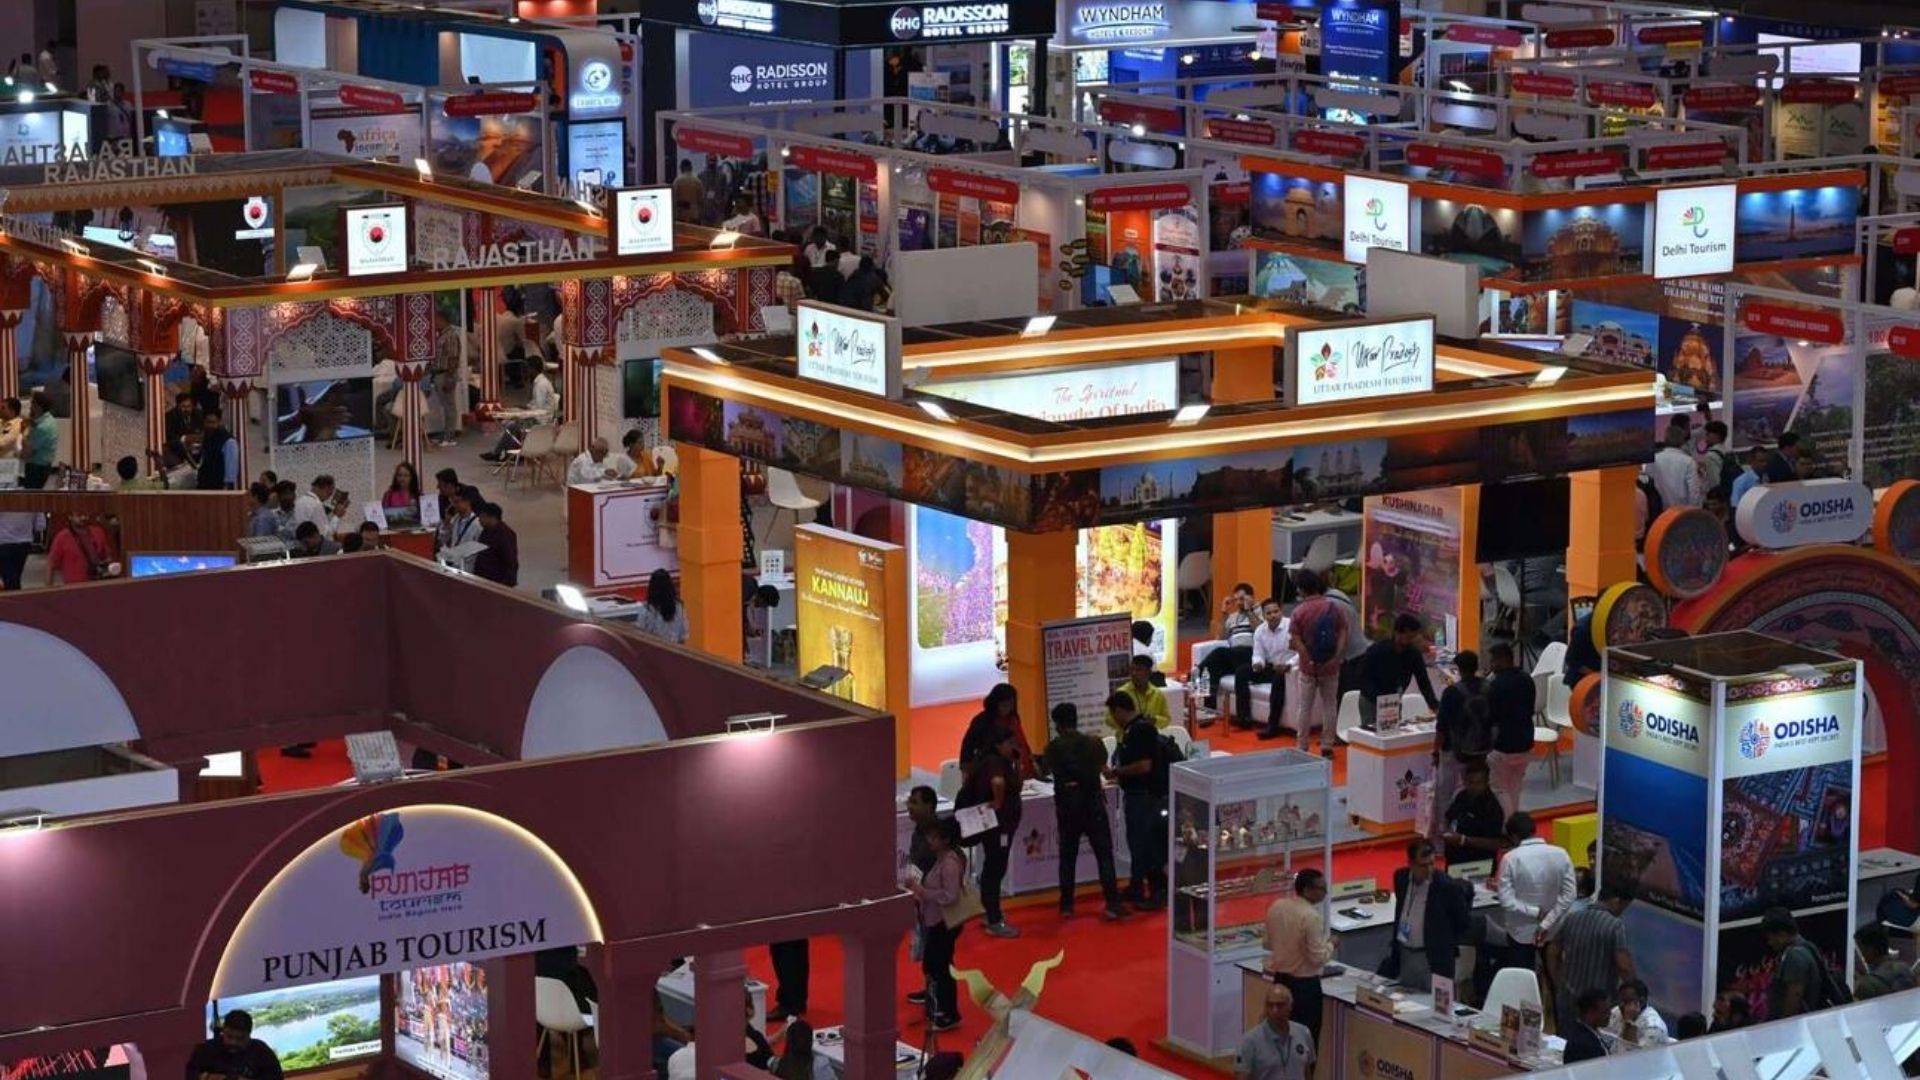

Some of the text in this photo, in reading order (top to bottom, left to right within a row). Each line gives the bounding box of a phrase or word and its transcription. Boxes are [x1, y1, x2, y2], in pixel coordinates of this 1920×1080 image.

[923, 4, 1008, 22] RADISSON
[1080, 5, 1165, 23] WYNDHAM
[1331, 8, 1380, 25] WYNDHAM
[891, 17, 920, 31] RHG
[923, 23, 1009, 37] HOTEL GROUP
[730, 73, 753, 84] RHG
[756, 62, 828, 79] RADISSON
[757, 79, 828, 90] HOTEL GROUP
[44, 156, 196, 184] RAJASTHAN
[1350, 230, 1402, 249] Delhi Tourism
[1662, 242, 1727, 257] Delhi Tourism
[434, 238, 595, 272] RAJASTHAN
[1313, 374, 1423, 395] UTTAR PRADESH TOURISM
[1382, 494, 1444, 519] KUSHINAGAR
[1799, 497, 1855, 518] ODISHA
[811, 575, 869, 607] KANNAUJ
[1046, 637, 1094, 660] TRAVEL
[1096, 631, 1129, 654] ZONE
[1646, 712, 1700, 744] ODISHA
[1774, 714, 1840, 740] ODISHA
[370, 863, 471, 899] PUNJAB
[377, 912, 402, 922] India
[440, 903, 464, 914] Here
[379, 891, 462, 913] tourism
[262, 917, 548, 983] PUNJAB TOURISM
[1377, 1057, 1414, 1080] ODISHA
